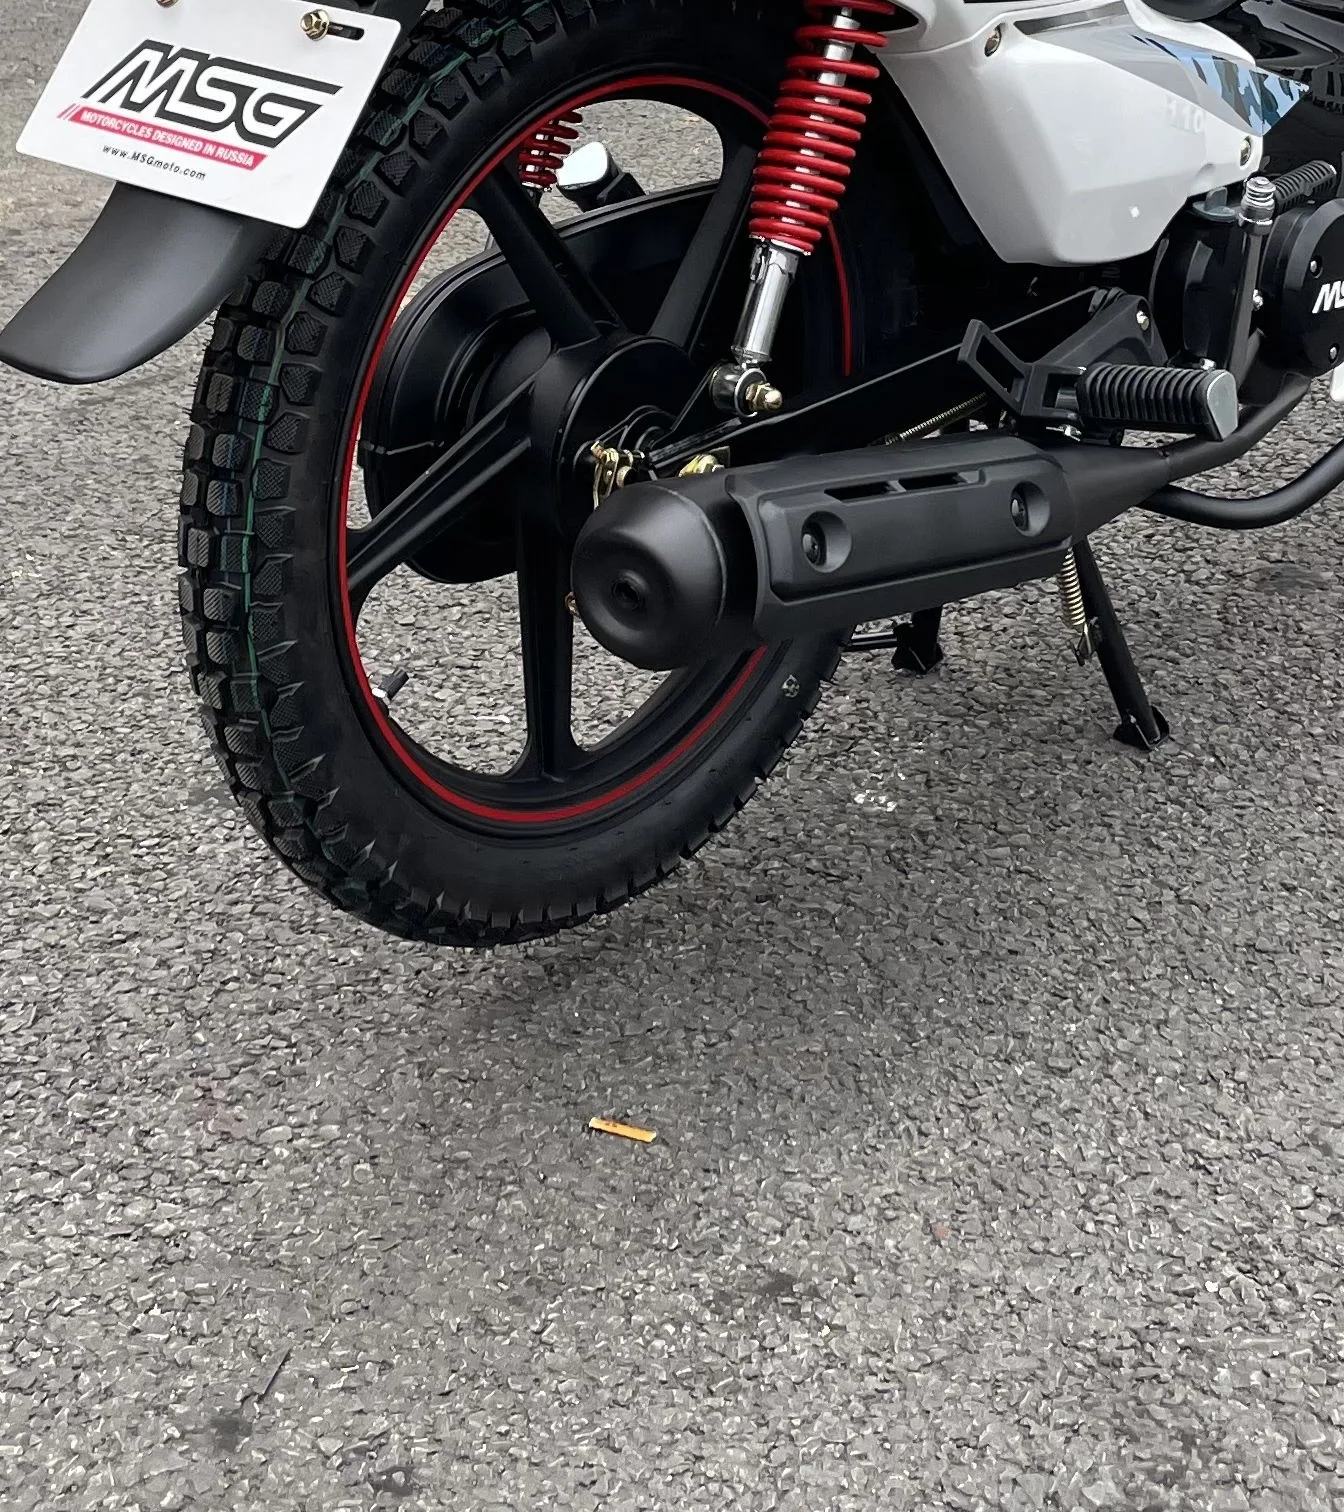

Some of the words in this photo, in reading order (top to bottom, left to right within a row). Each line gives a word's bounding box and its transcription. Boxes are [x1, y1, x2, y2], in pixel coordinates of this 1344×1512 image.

[81, 39, 344, 149] MSG
[80, 110, 153, 139] MOTORCYCLES
[152, 129, 203, 153] DESIGNED
[202, 142, 217, 156] IN
[215, 147, 255, 167] RUSSIA
[103, 145, 206, 180] www.MSGmoto.com
